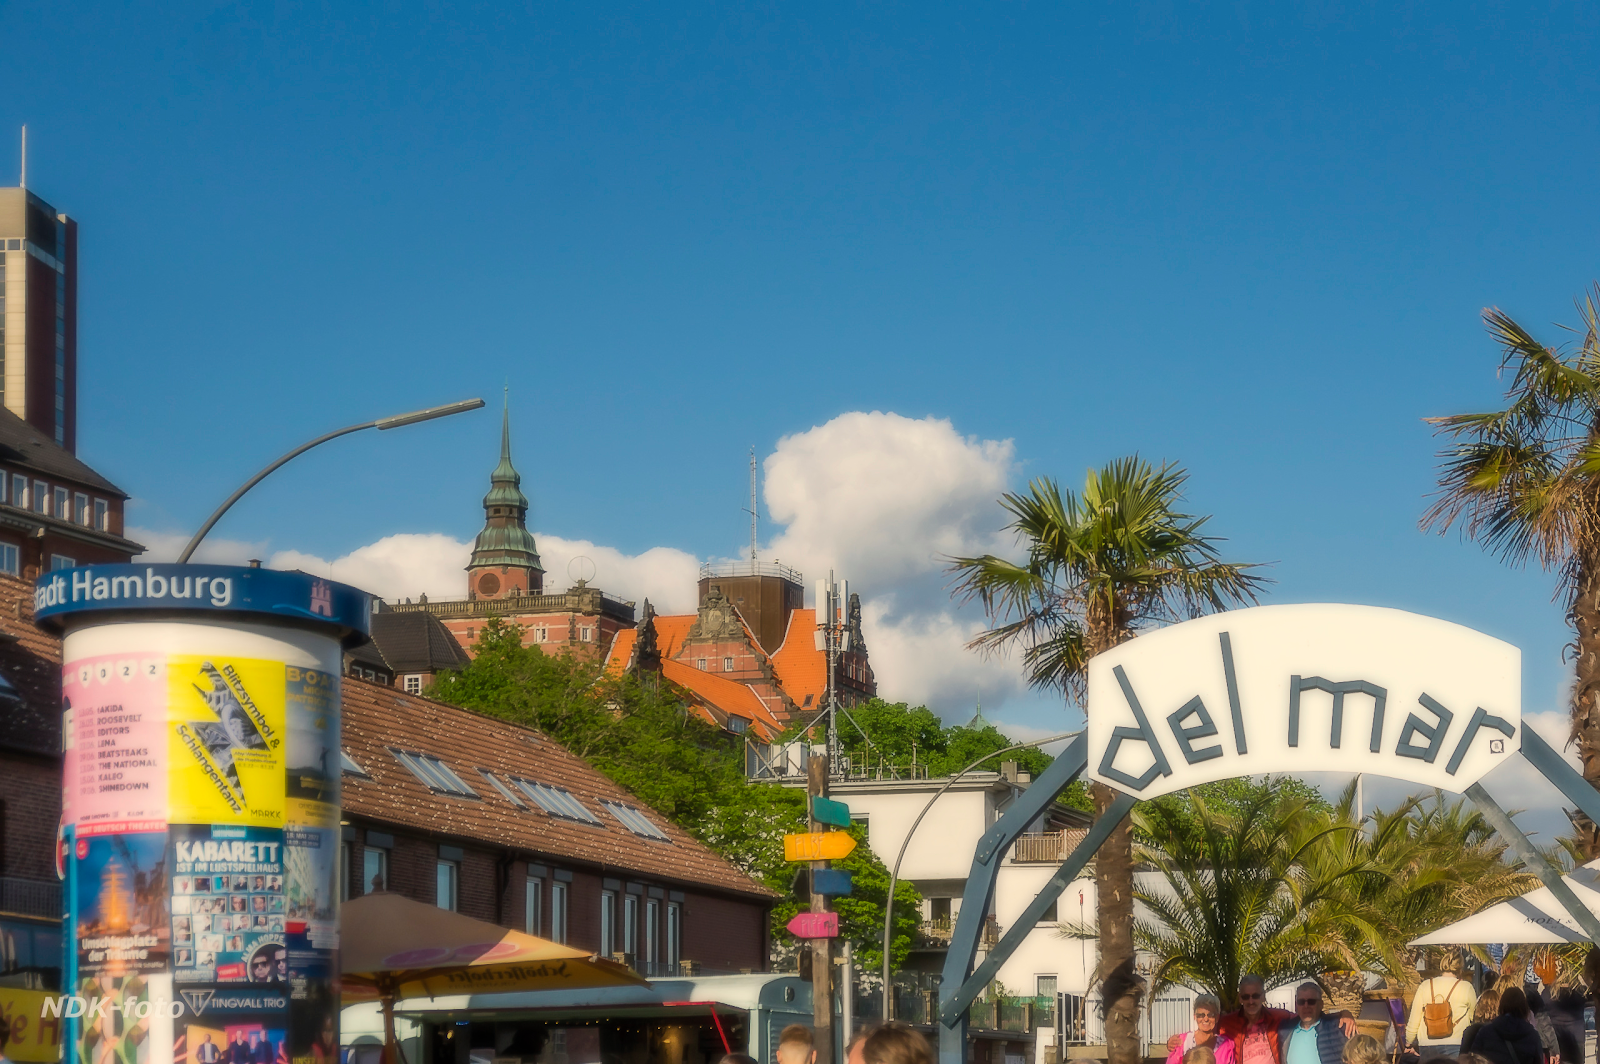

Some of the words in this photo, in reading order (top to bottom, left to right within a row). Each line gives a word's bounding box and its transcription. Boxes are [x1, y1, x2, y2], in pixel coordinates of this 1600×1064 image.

[72, 568, 232, 607] Hamburg
[222, 664, 275, 738] Blitzsymbol
[269, 738, 280, 749] &
[1098, 631, 1247, 791] del
[1288, 674, 1516, 776] mar
[97, 714, 142, 726] ROOSEVELT
[97, 726, 130, 737] EDITORS
[98, 739, 116, 748] LENA
[98, 748, 148, 759] BEATSTEAKS
[99, 762, 111, 770] THE
[113, 759, 157, 769] NATIONAL
[176, 724, 242, 815] Schlangentanz
[99, 782, 149, 793] SHINEDOWN
[250, 810, 281, 819] MARKK
[128, 821, 166, 831] THEATER
[175, 841, 280, 863] KABARETT
[176, 862, 192, 873] IST
[194, 862, 208, 872] IM
[209, 862, 280, 873] LUSTSPIELHAUS
[241, 940, 259, 962] ALMA
[211, 998, 263, 1009] TINGVALL
[263, 998, 286, 1009] TRIO
